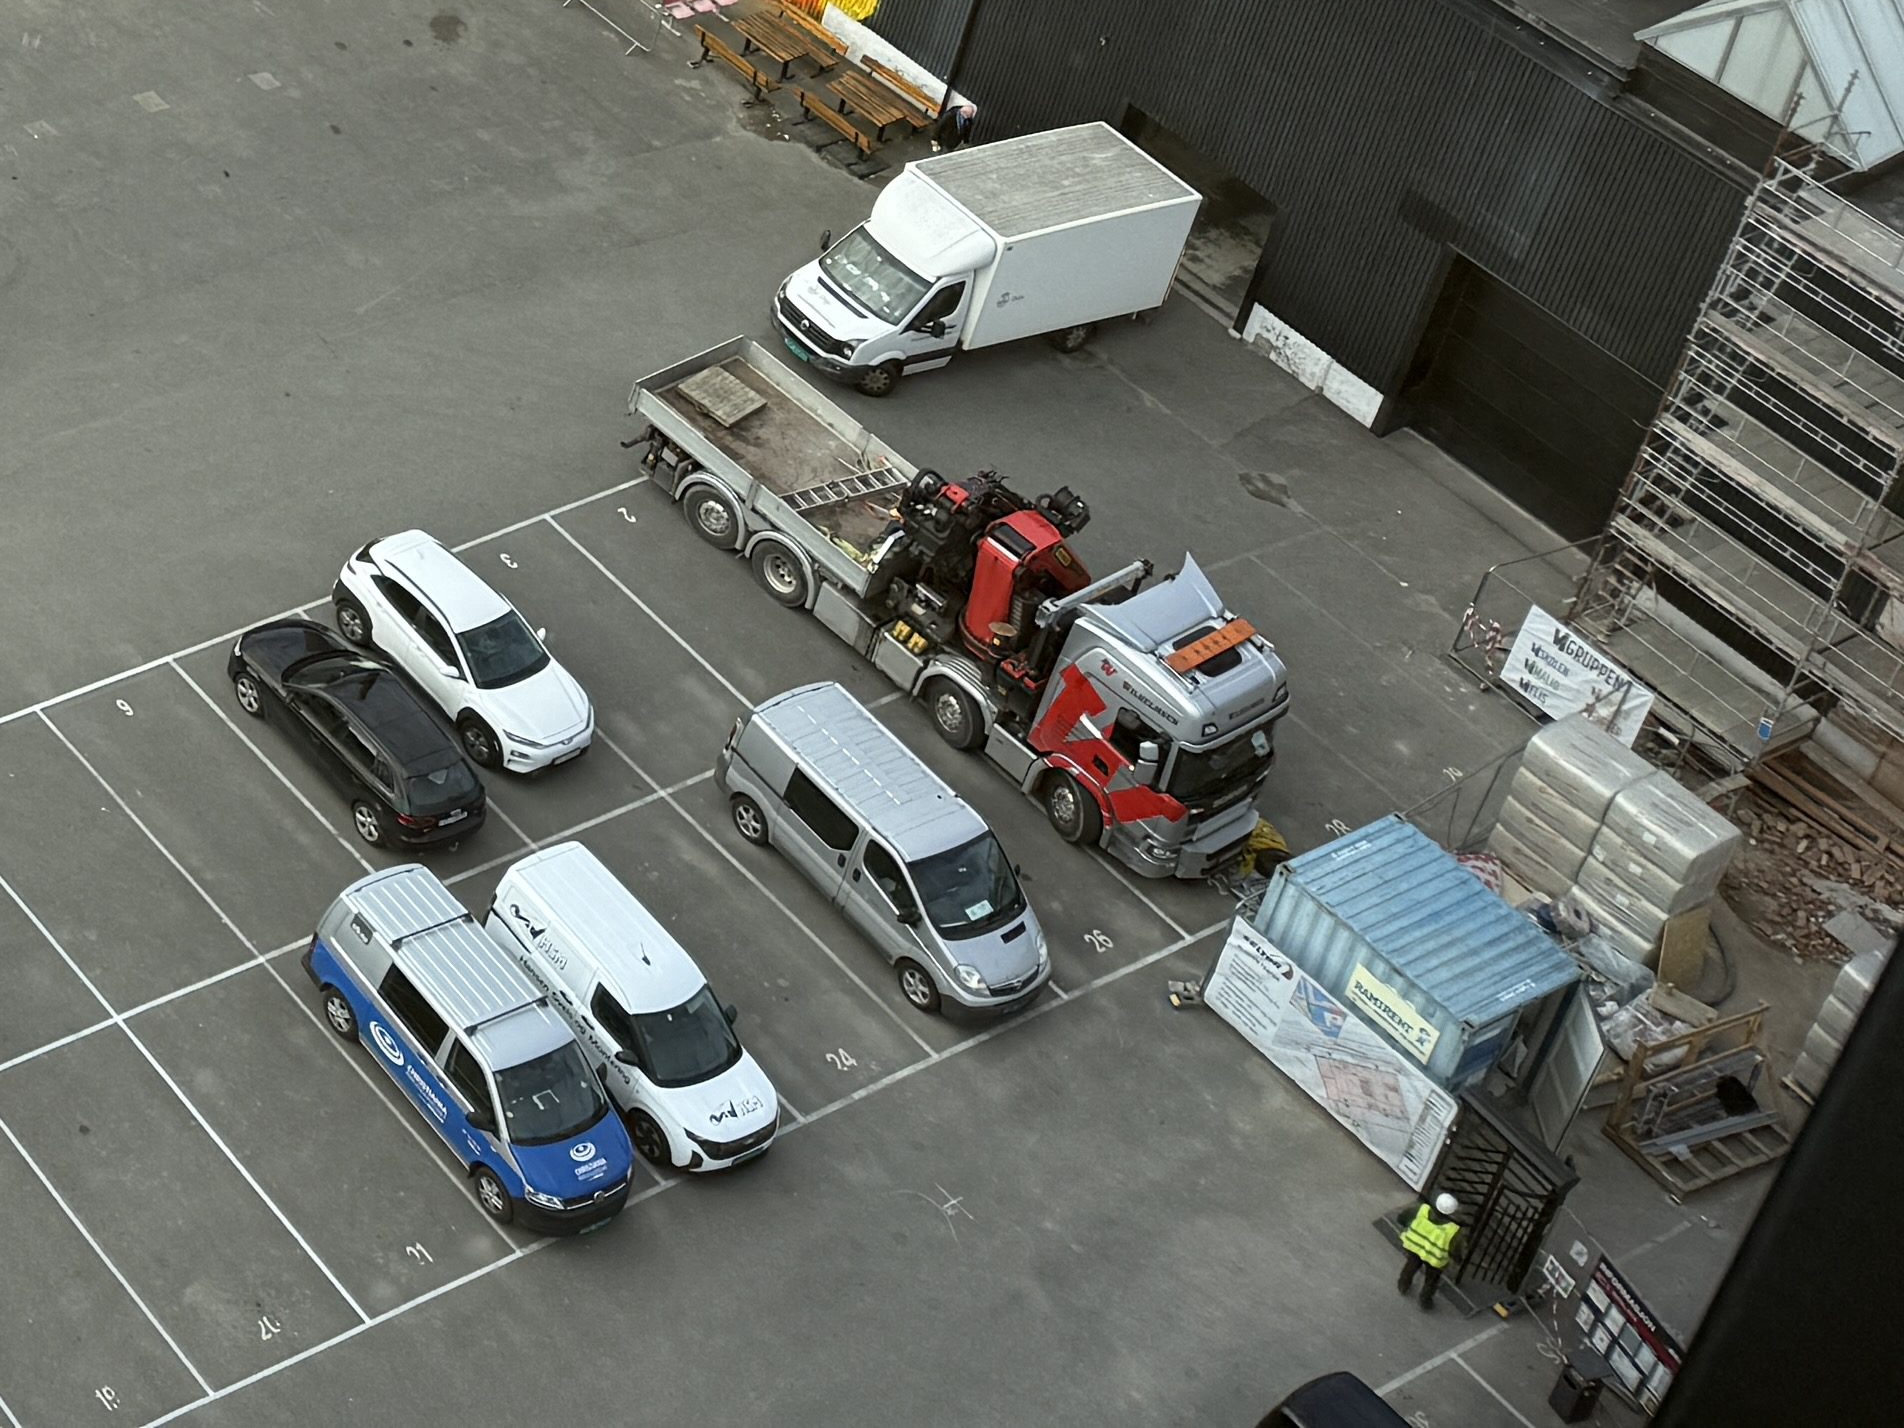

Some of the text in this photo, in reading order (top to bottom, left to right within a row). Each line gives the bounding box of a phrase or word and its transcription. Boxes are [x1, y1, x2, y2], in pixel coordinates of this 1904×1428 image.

[617, 507, 637, 523] 2
[499, 553, 518, 569] 3
[1084, 929, 1114, 953] 26
[1353, 979, 1414, 1036] RAMIRENT
[519, 954, 550, 992] Hansen
[588, 1033, 630, 1086] Montering
